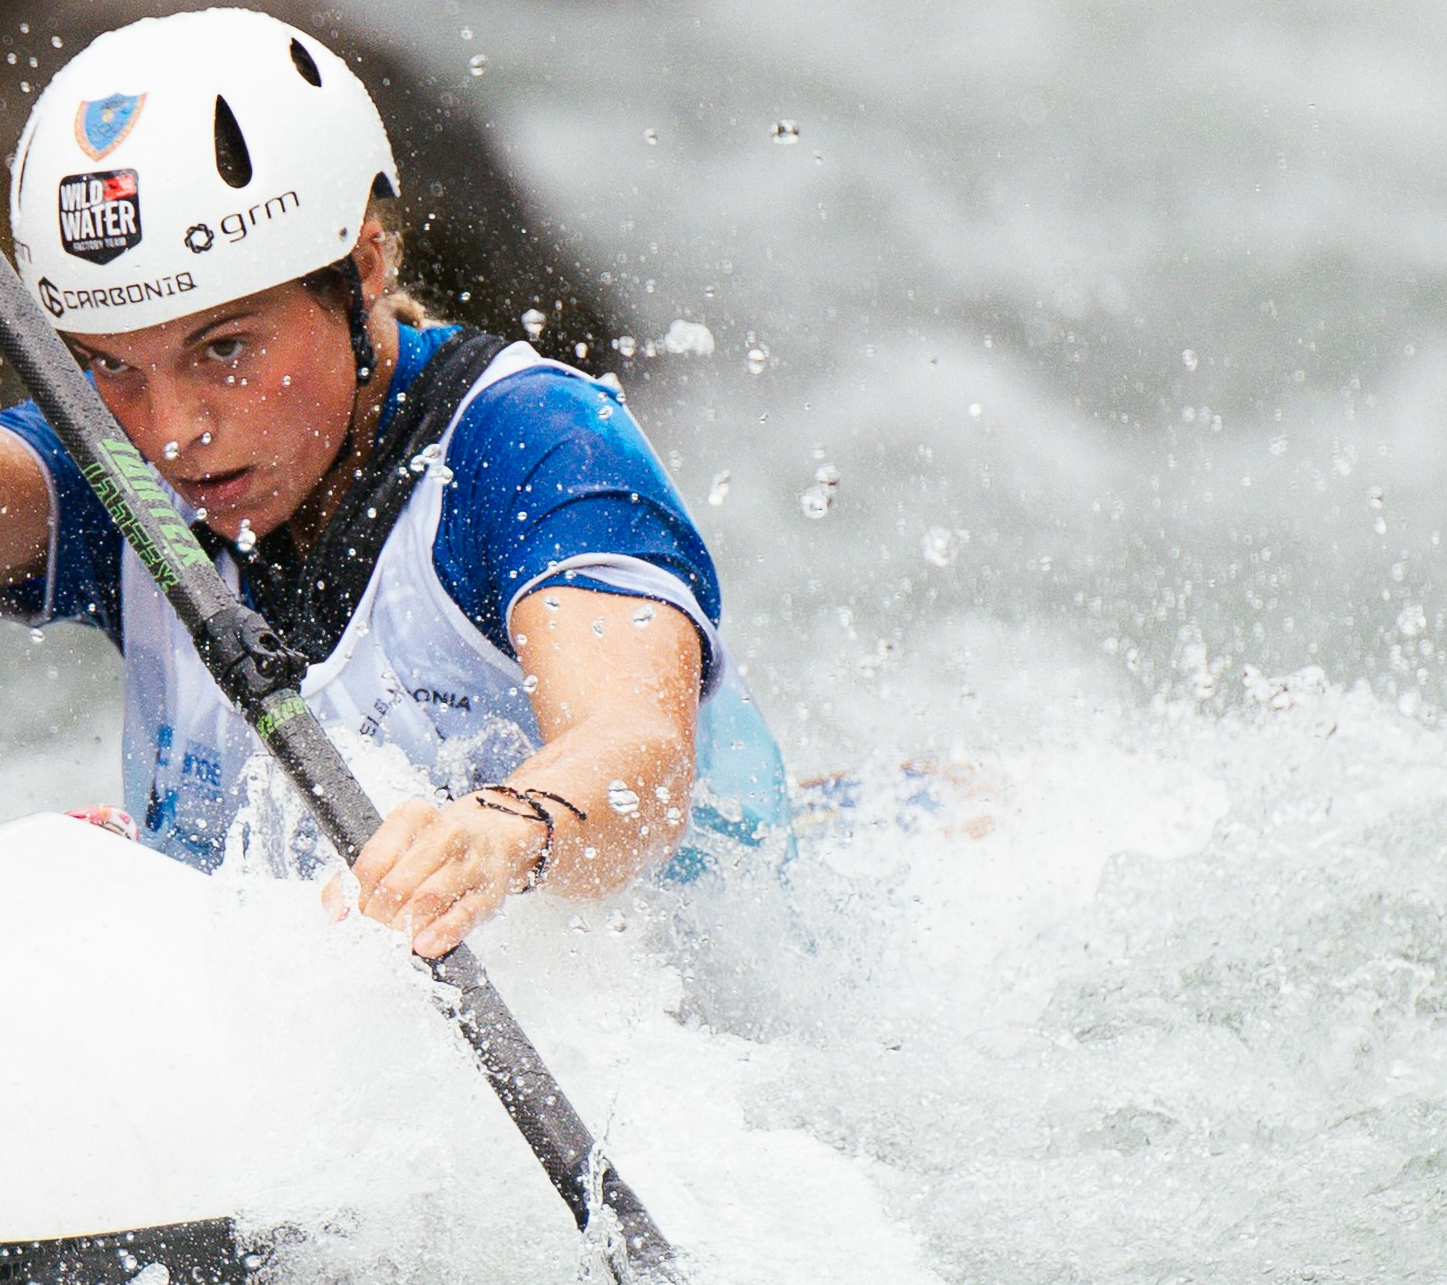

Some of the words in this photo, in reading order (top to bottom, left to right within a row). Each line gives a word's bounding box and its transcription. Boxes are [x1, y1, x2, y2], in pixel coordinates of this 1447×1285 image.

[60, 179, 104, 211] WILD
[60, 200, 136, 241] WATER
[220, 191, 299, 243] grm
